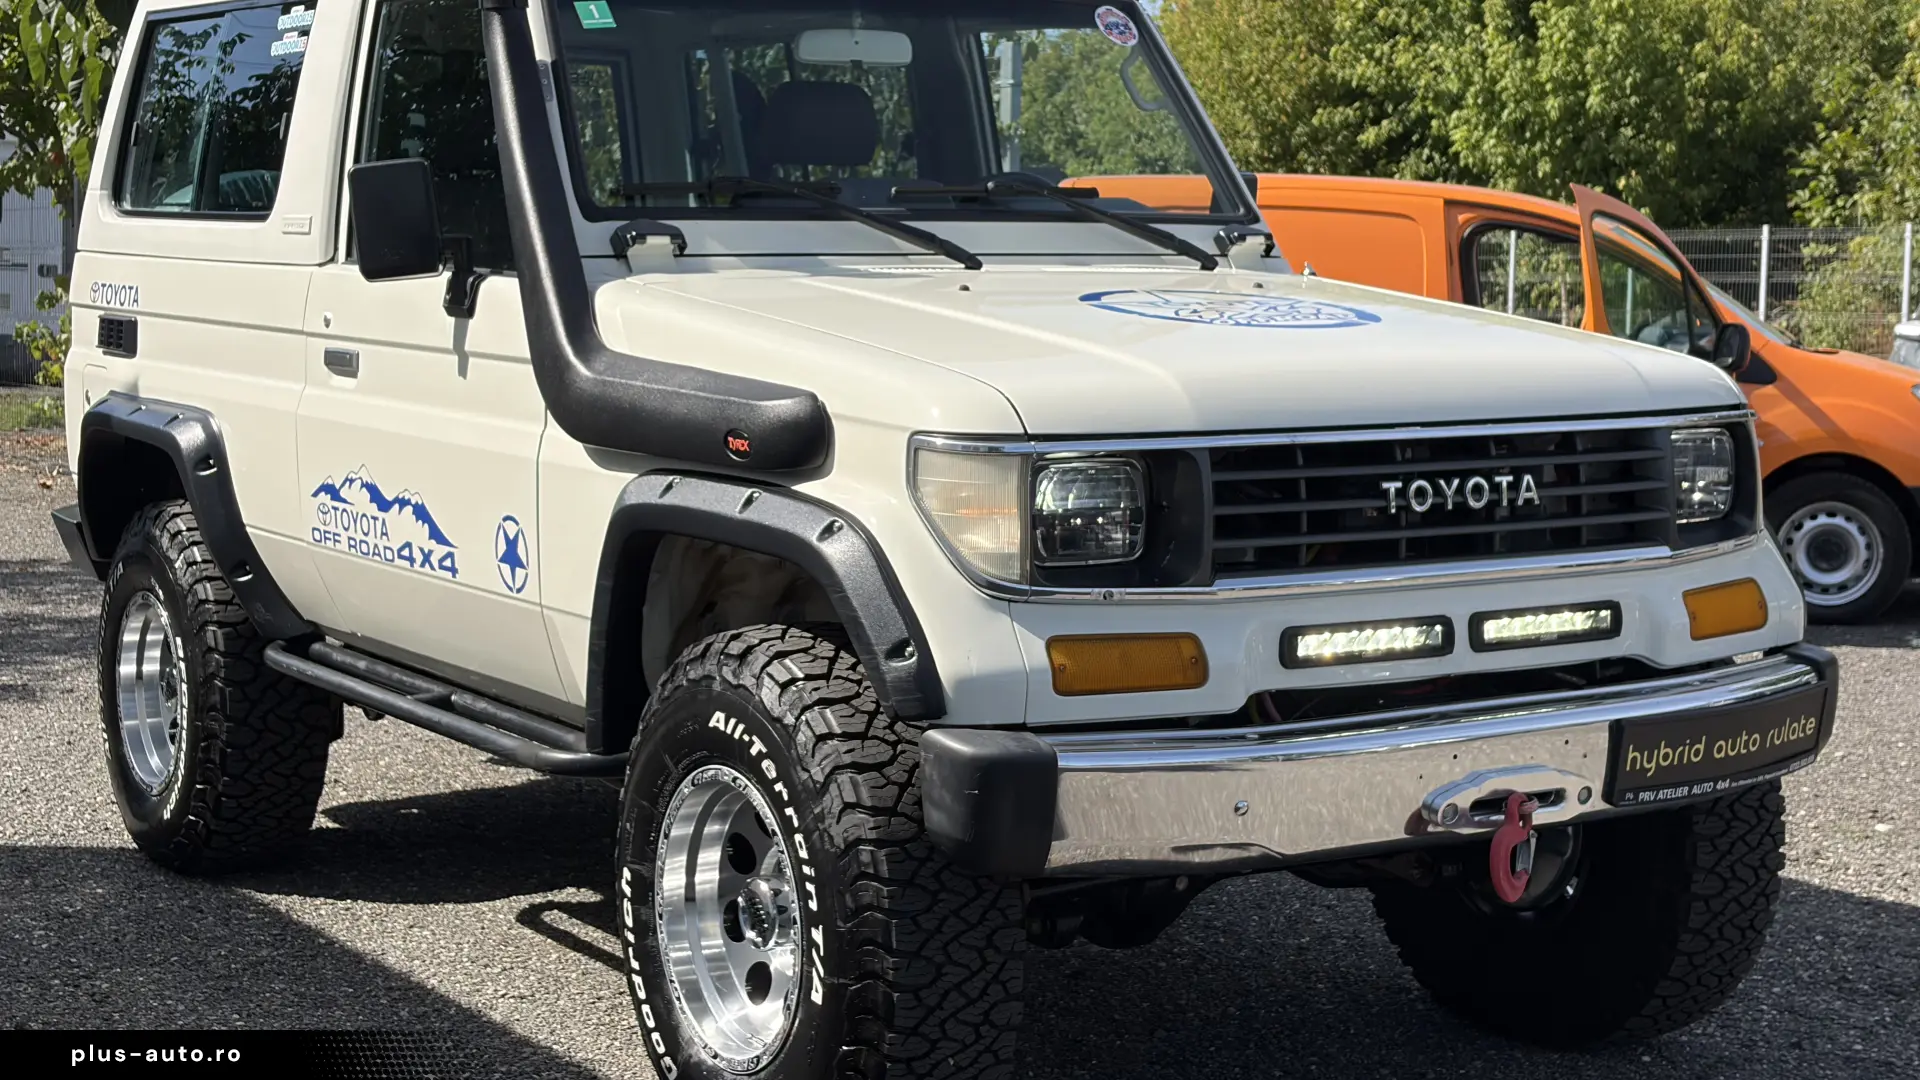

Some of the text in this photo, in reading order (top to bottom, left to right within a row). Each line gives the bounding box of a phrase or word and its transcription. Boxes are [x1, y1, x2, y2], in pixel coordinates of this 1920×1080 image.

[588, 4, 599, 18] 1
[100, 282, 139, 308] TOYOTA
[1380, 474, 1540, 514] TOYOTA
[331, 505, 391, 542] TOYOTA
[311, 527, 341, 548] OFF
[347, 536, 395, 563] ROAD
[1626, 716, 1816, 777] hybrid auto rulate
[1638, 789, 1657, 802] PRV
[1657, 786, 1689, 801] ATELIER
[1691, 781, 1714, 796] AUTO
[707, 709, 818, 912] All-Terrain
[810, 924, 825, 1007] T/A
